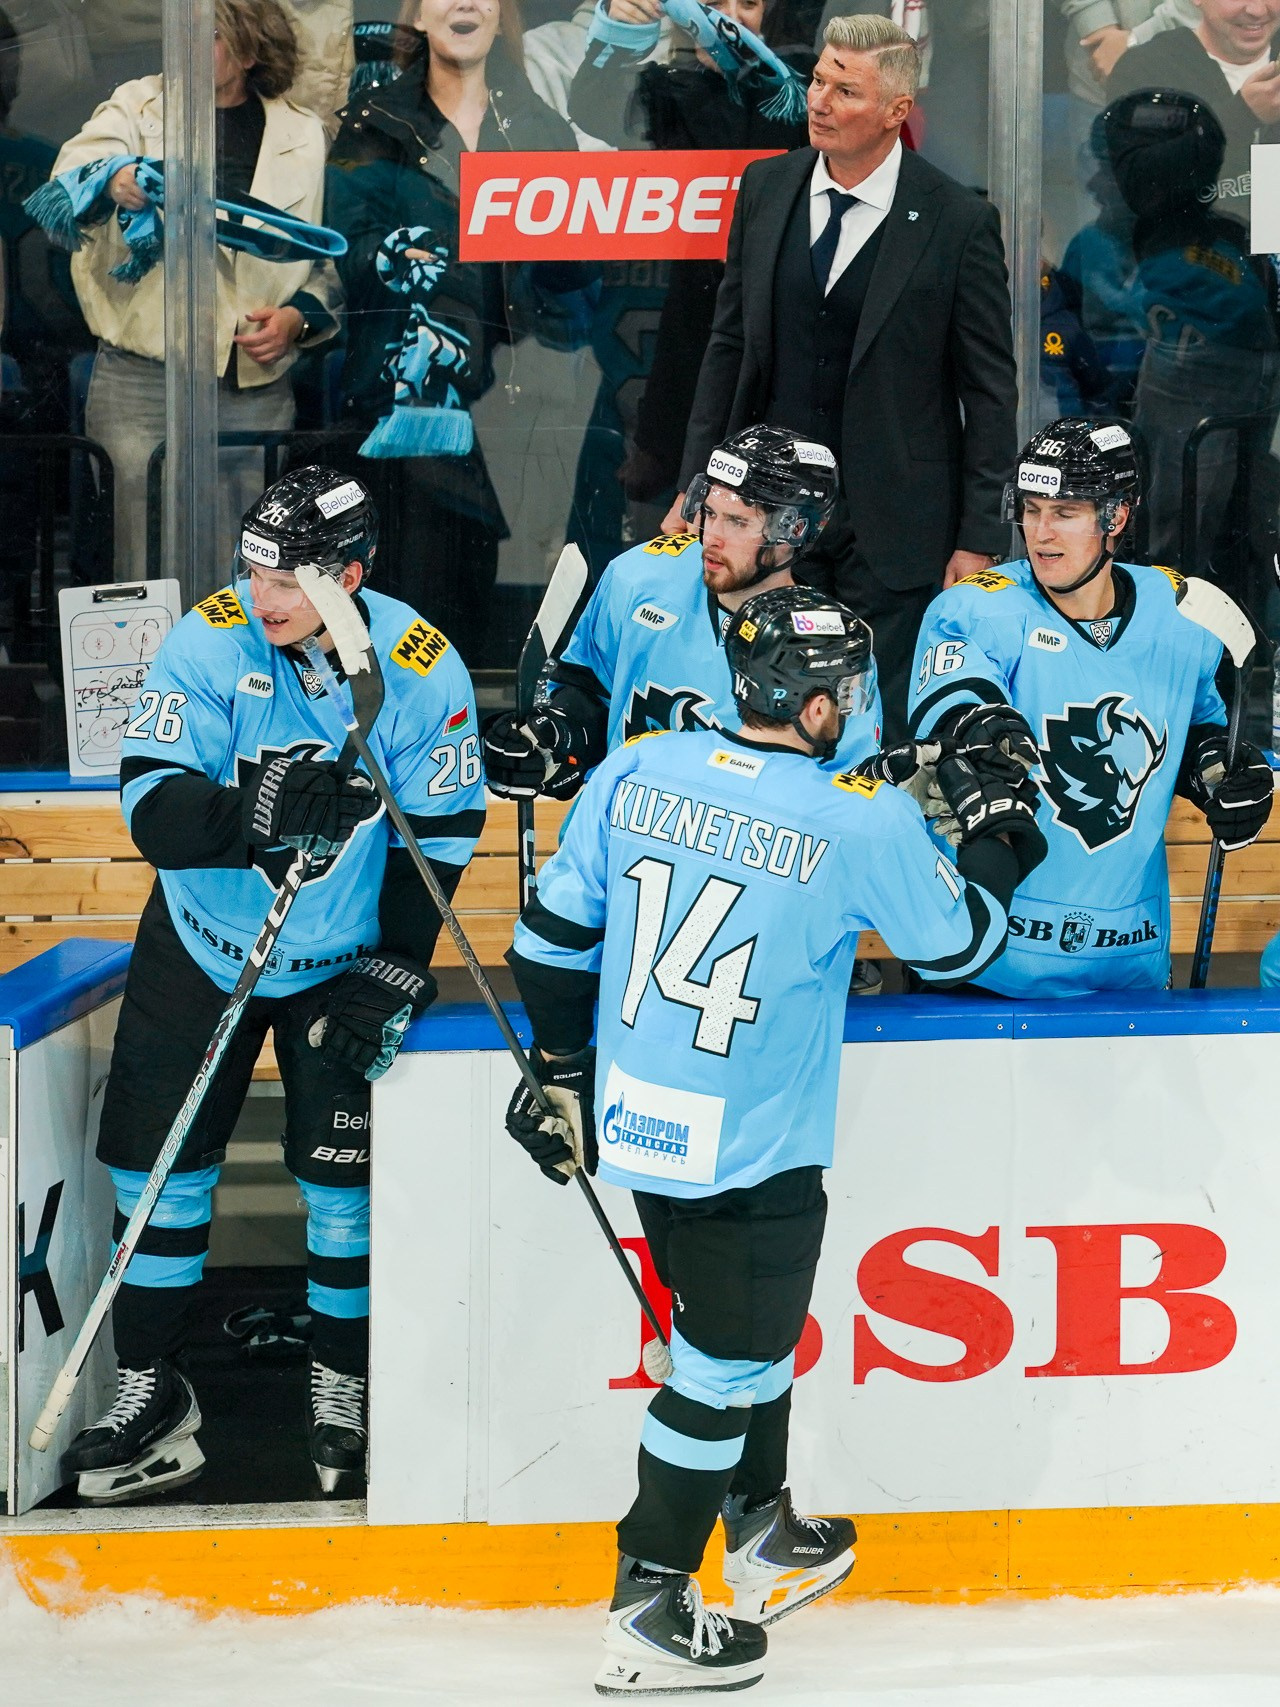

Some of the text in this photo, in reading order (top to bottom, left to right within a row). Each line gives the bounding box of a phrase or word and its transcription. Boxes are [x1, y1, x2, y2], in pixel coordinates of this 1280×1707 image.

[467, 176, 742, 236] FONBE
[1036, 439, 1065, 457] 96
[257, 502, 288, 526] 26
[318, 487, 365, 515] Belavia
[197, 600, 228, 625] LINE
[214, 592, 243, 624] MAX
[639, 608, 665, 625] МИР
[815, 622, 844, 632] belbet
[1037, 632, 1061, 647] МИР
[397, 624, 431, 662] MAX
[415, 632, 447, 669] LINE
[916, 640, 968, 696] 96
[248, 676, 272, 693] МИР
[734, 672, 749, 701] 14
[123, 689, 189, 745] 26
[427, 733, 482, 797] 26
[729, 758, 756, 772] БАНК
[552, 771, 580, 789] CCM
[966, 797, 1039, 832] UER
[610, 780, 830, 885] KUZNETSOV
[249, 849, 314, 969] CCM
[181, 906, 377, 974] BSB Bank
[1007, 916, 1159, 949] SB Bank
[622, 855, 762, 1058] 14
[553, 1071, 583, 1081] BAUER
[144, 1072, 210, 1206] JETSPEED
[623, 1110, 690, 1144] ГАЗПРОМ
[310, 1145, 370, 1164] BAU
[619, 1143, 687, 1165] БЕЛАРУСЬ
[622, 1132, 687, 1155] ТРАНСГАЗ
[791, 1545, 825, 1556] BAUER
